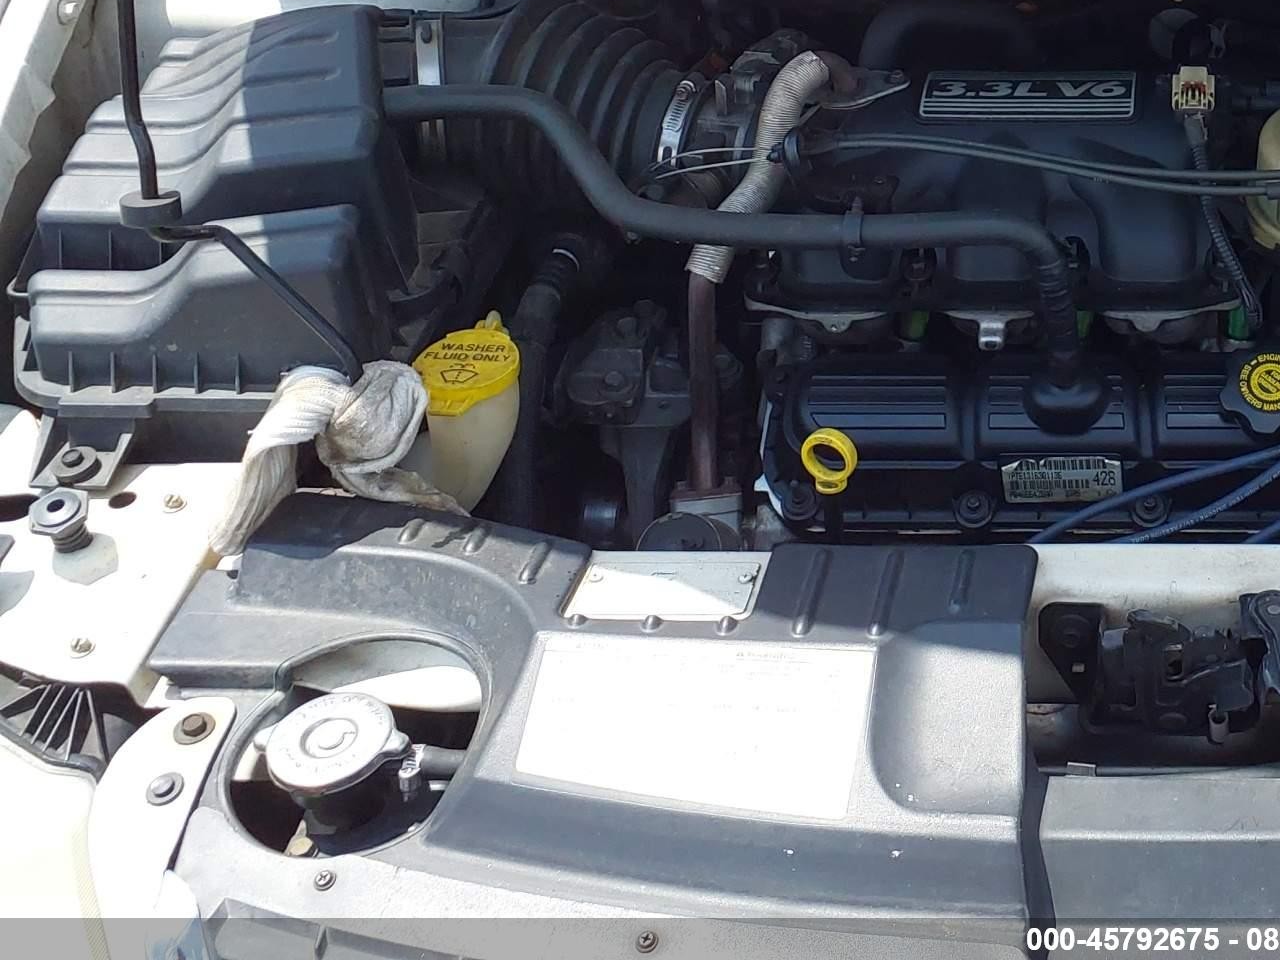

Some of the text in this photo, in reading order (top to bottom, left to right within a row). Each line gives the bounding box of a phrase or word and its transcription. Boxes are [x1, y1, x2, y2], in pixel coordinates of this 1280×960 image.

[932, 80, 1127, 97] 3.3L V6
[441, 343, 507, 353] WASHER
[424, 351, 511, 362] FLUID ONLY
[1240, 364, 1252, 380] SEE
[1240, 381, 1262, 408] OWNERS
[1092, 470, 1117, 487] 428
